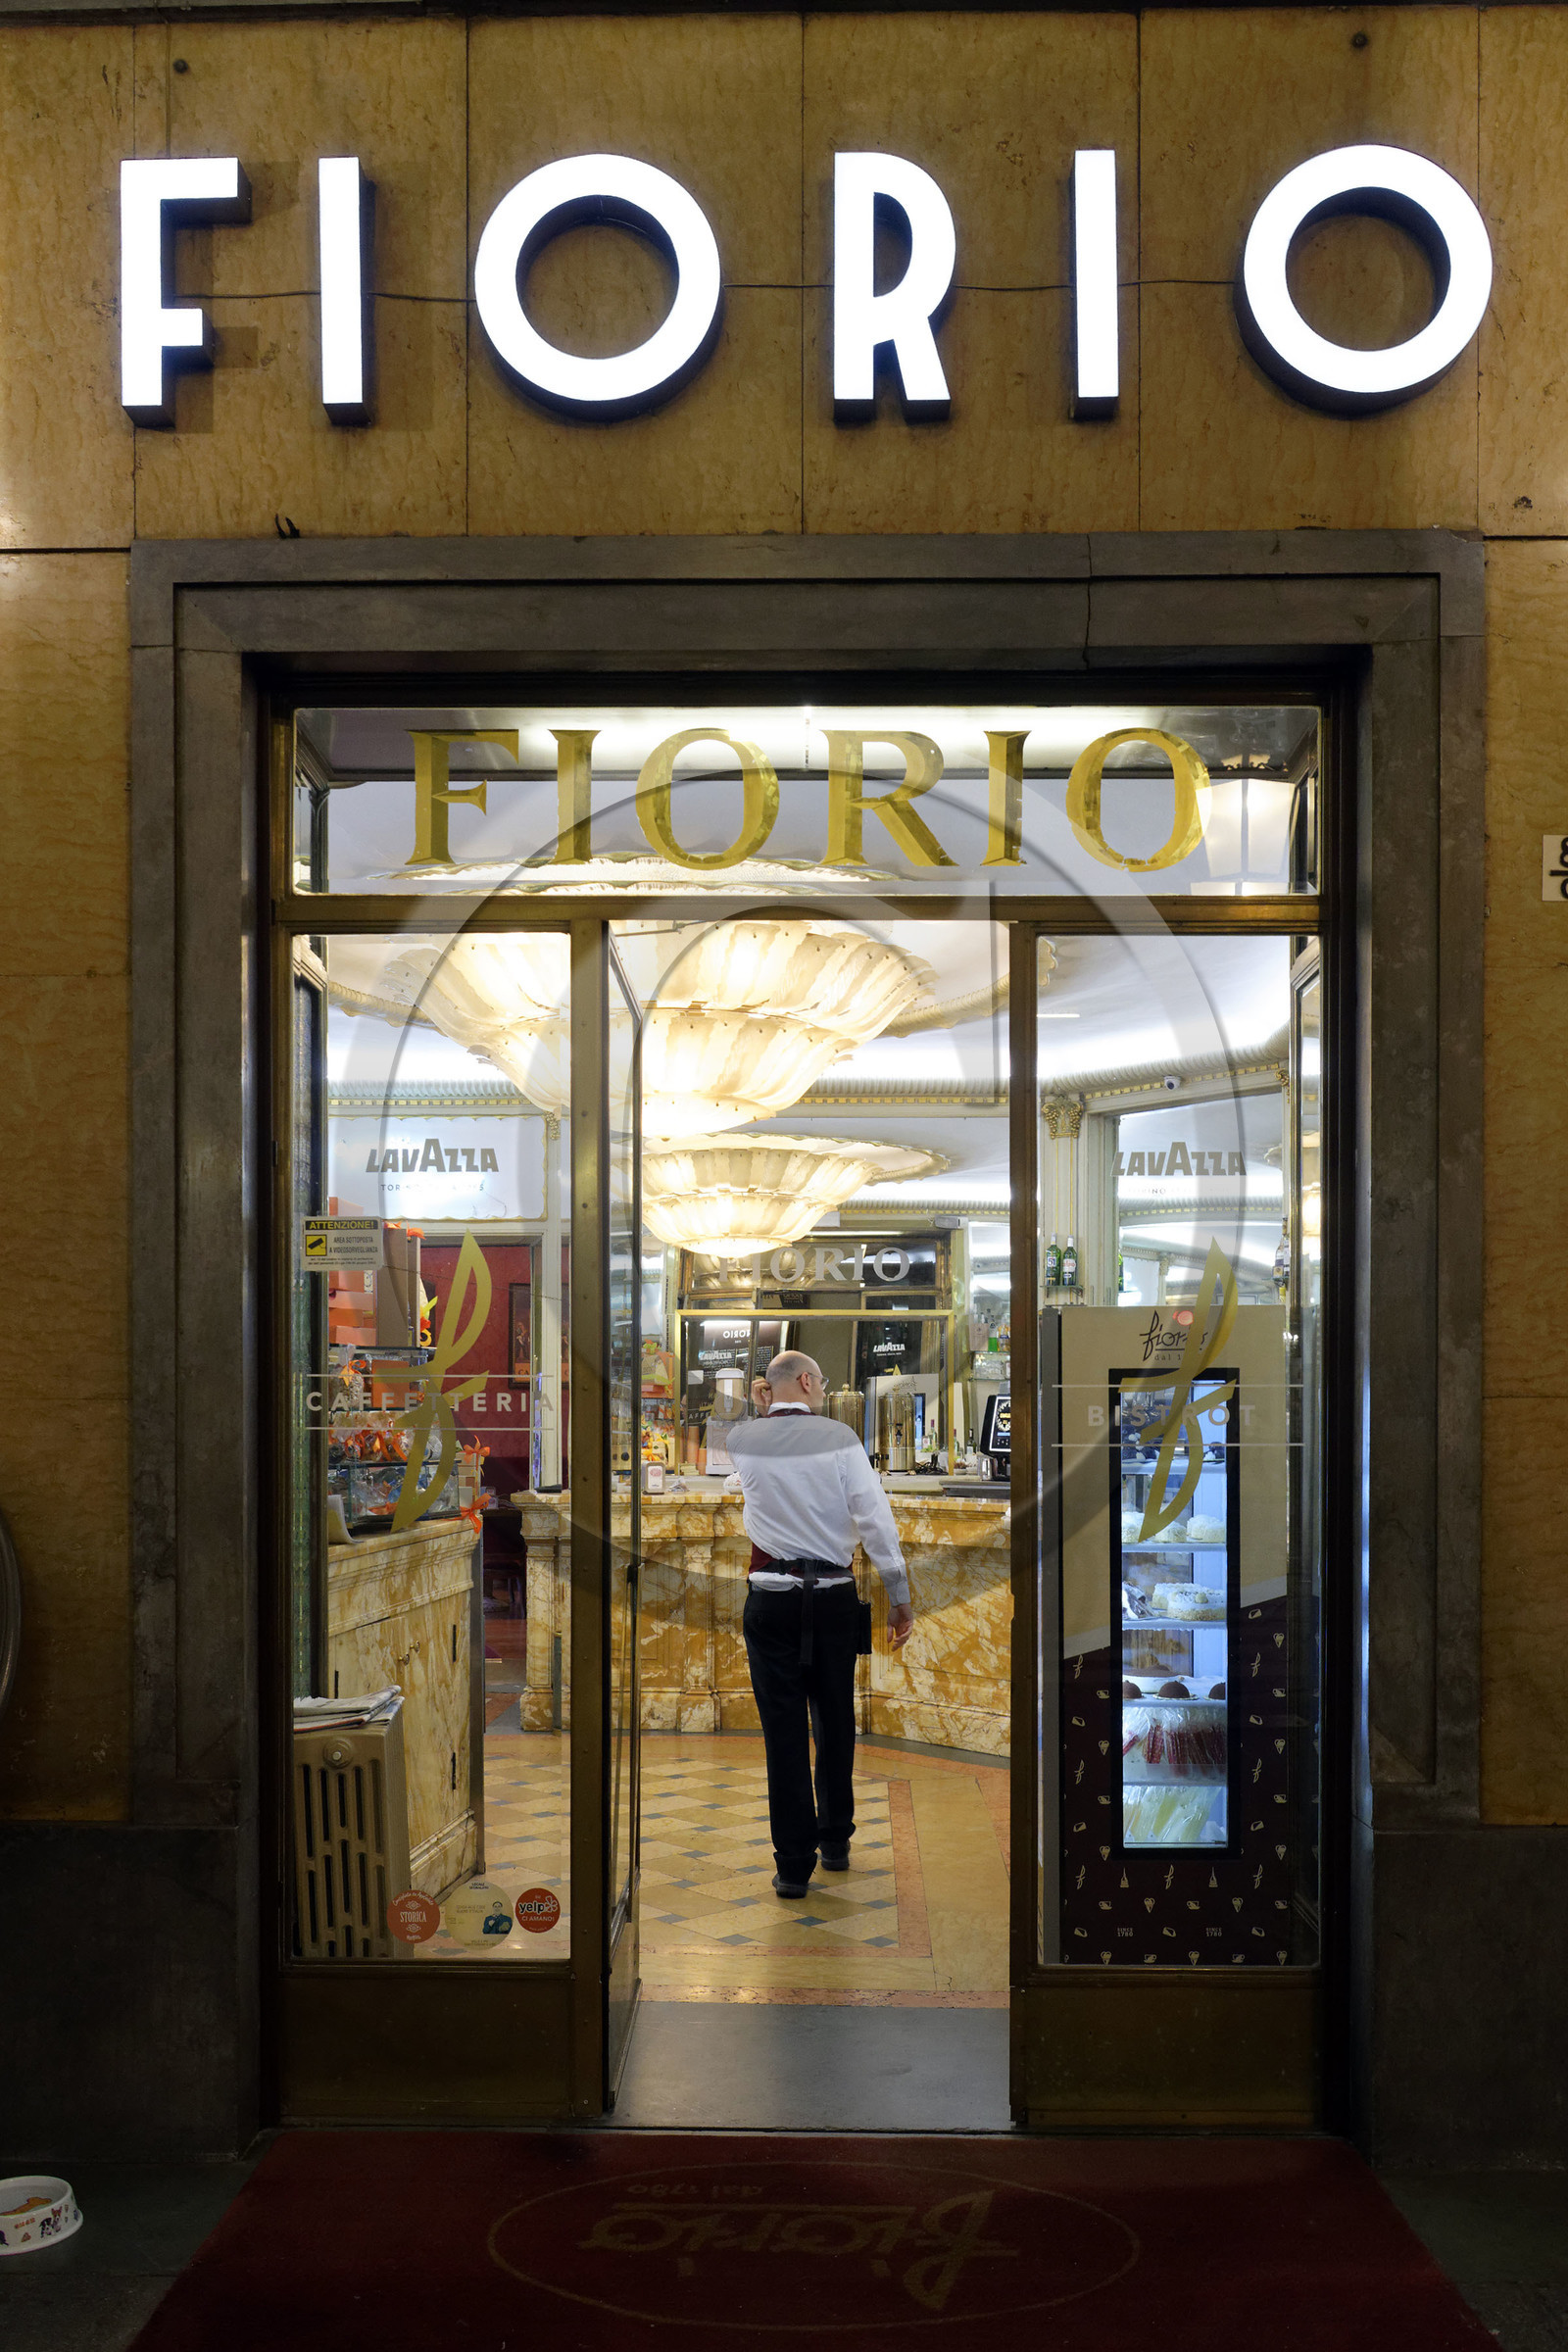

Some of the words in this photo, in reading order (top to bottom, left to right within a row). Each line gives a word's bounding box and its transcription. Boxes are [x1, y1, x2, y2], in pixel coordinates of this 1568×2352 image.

[119, 144, 1493, 410] FIORIO
[404, 727, 1211, 871] FIORIO
[366, 1138, 500, 1173] LAVAZZA
[1110, 1142, 1247, 1176] LAVAZZA
[309, 1220, 375, 1230] ATTENZIONE!
[306, 1392, 555, 1412] CAFFETTERIA
[1088, 1405, 1256, 1427] BISTROT
[400, 1911, 427, 1923] STORICA
[518, 1900, 545, 1915] yelp
